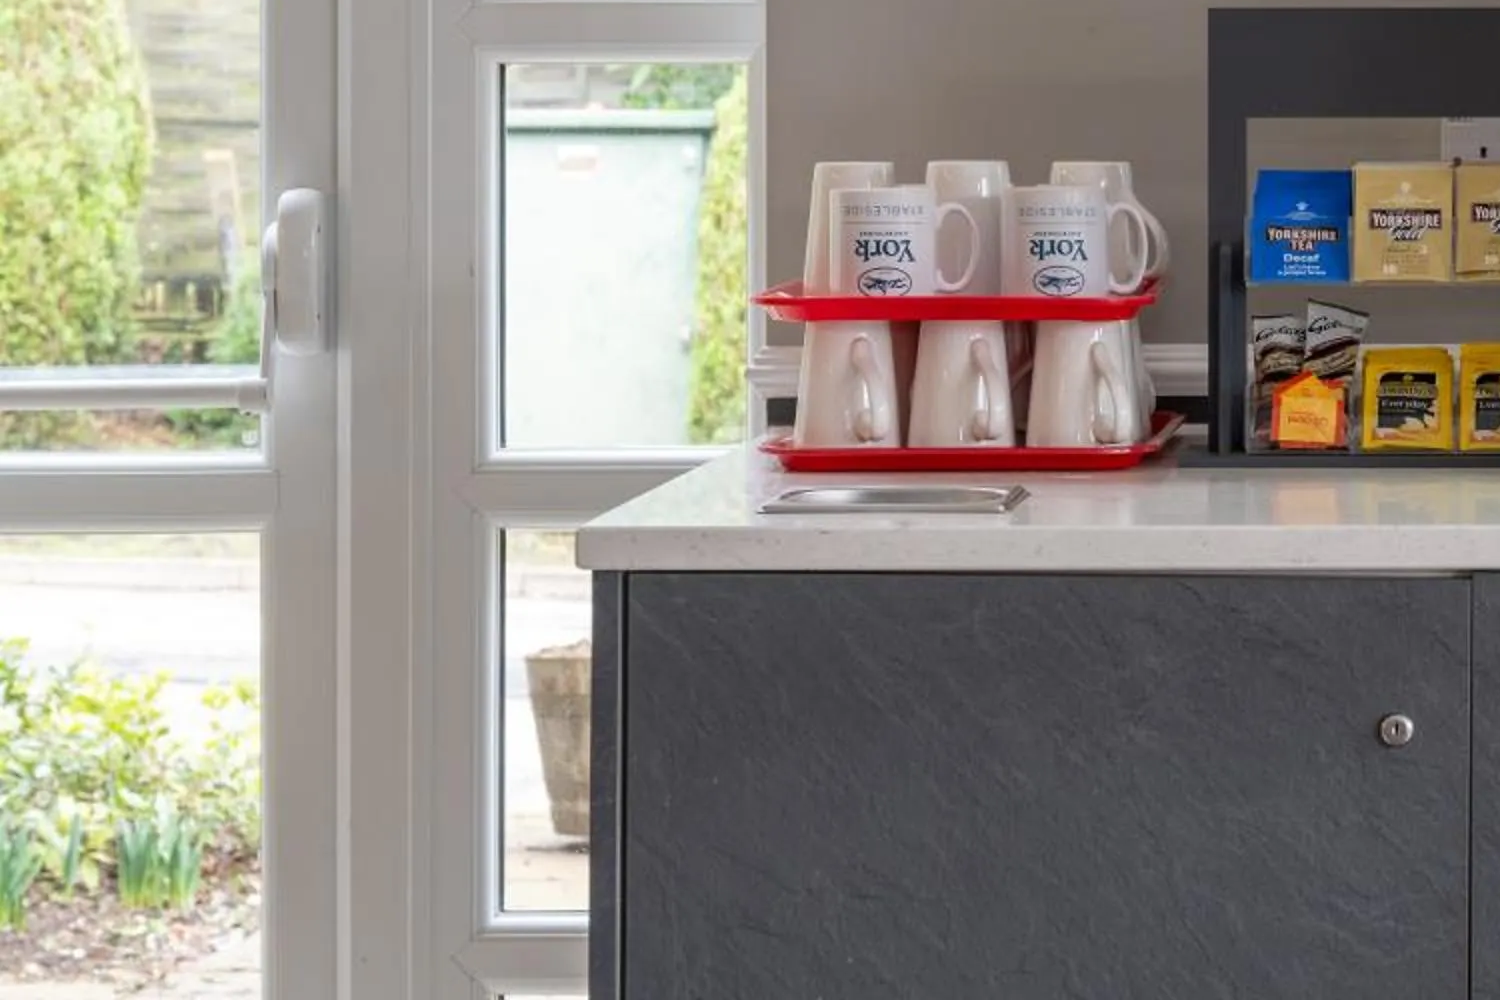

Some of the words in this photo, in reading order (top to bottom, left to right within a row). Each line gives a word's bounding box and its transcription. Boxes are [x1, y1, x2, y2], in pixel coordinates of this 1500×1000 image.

[1372, 212, 1441, 228] YORKSHIRE
[1267, 227, 1338, 241] YORKSHIRE
[853, 239, 916, 263] York
[1028, 239, 1088, 261] York
[1290, 240, 1314, 252] TEA
[1283, 253, 1321, 263] Decaf
